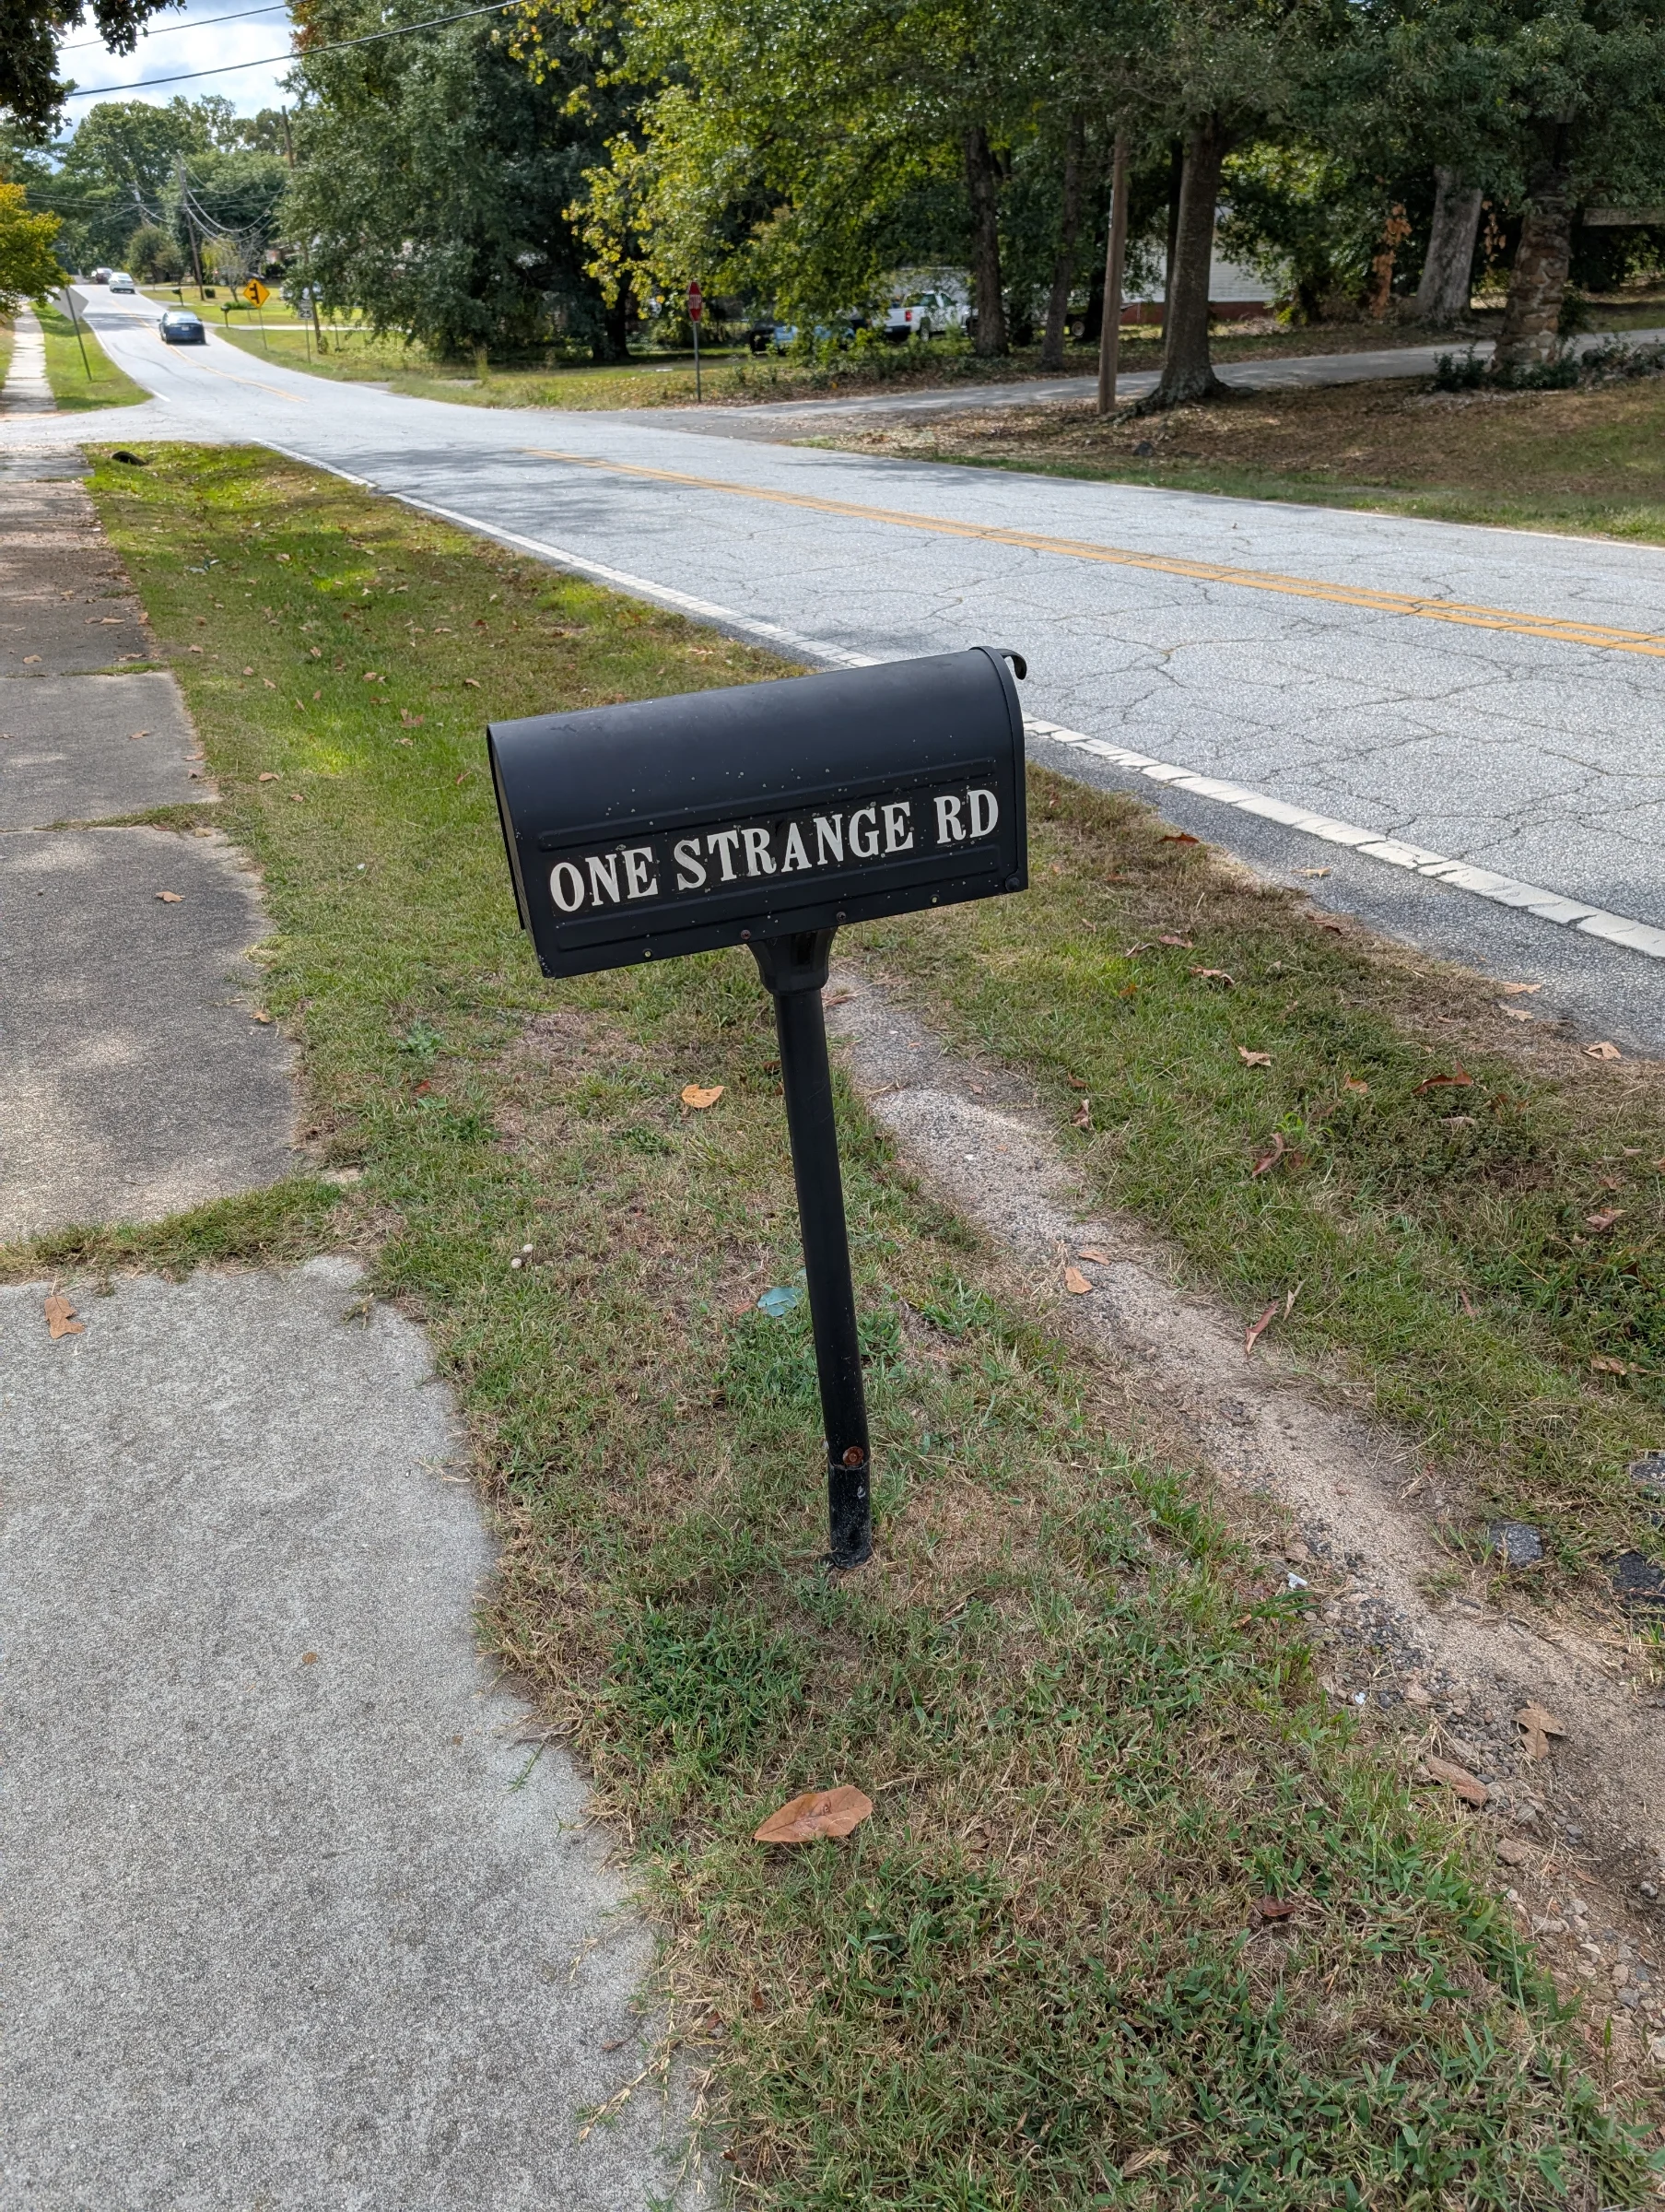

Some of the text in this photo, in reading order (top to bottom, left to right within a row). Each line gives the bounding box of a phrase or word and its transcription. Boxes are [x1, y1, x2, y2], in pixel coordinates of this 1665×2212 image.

[299, 310, 312, 318] 25
[550, 789, 999, 912] ONE STRANGE RD
